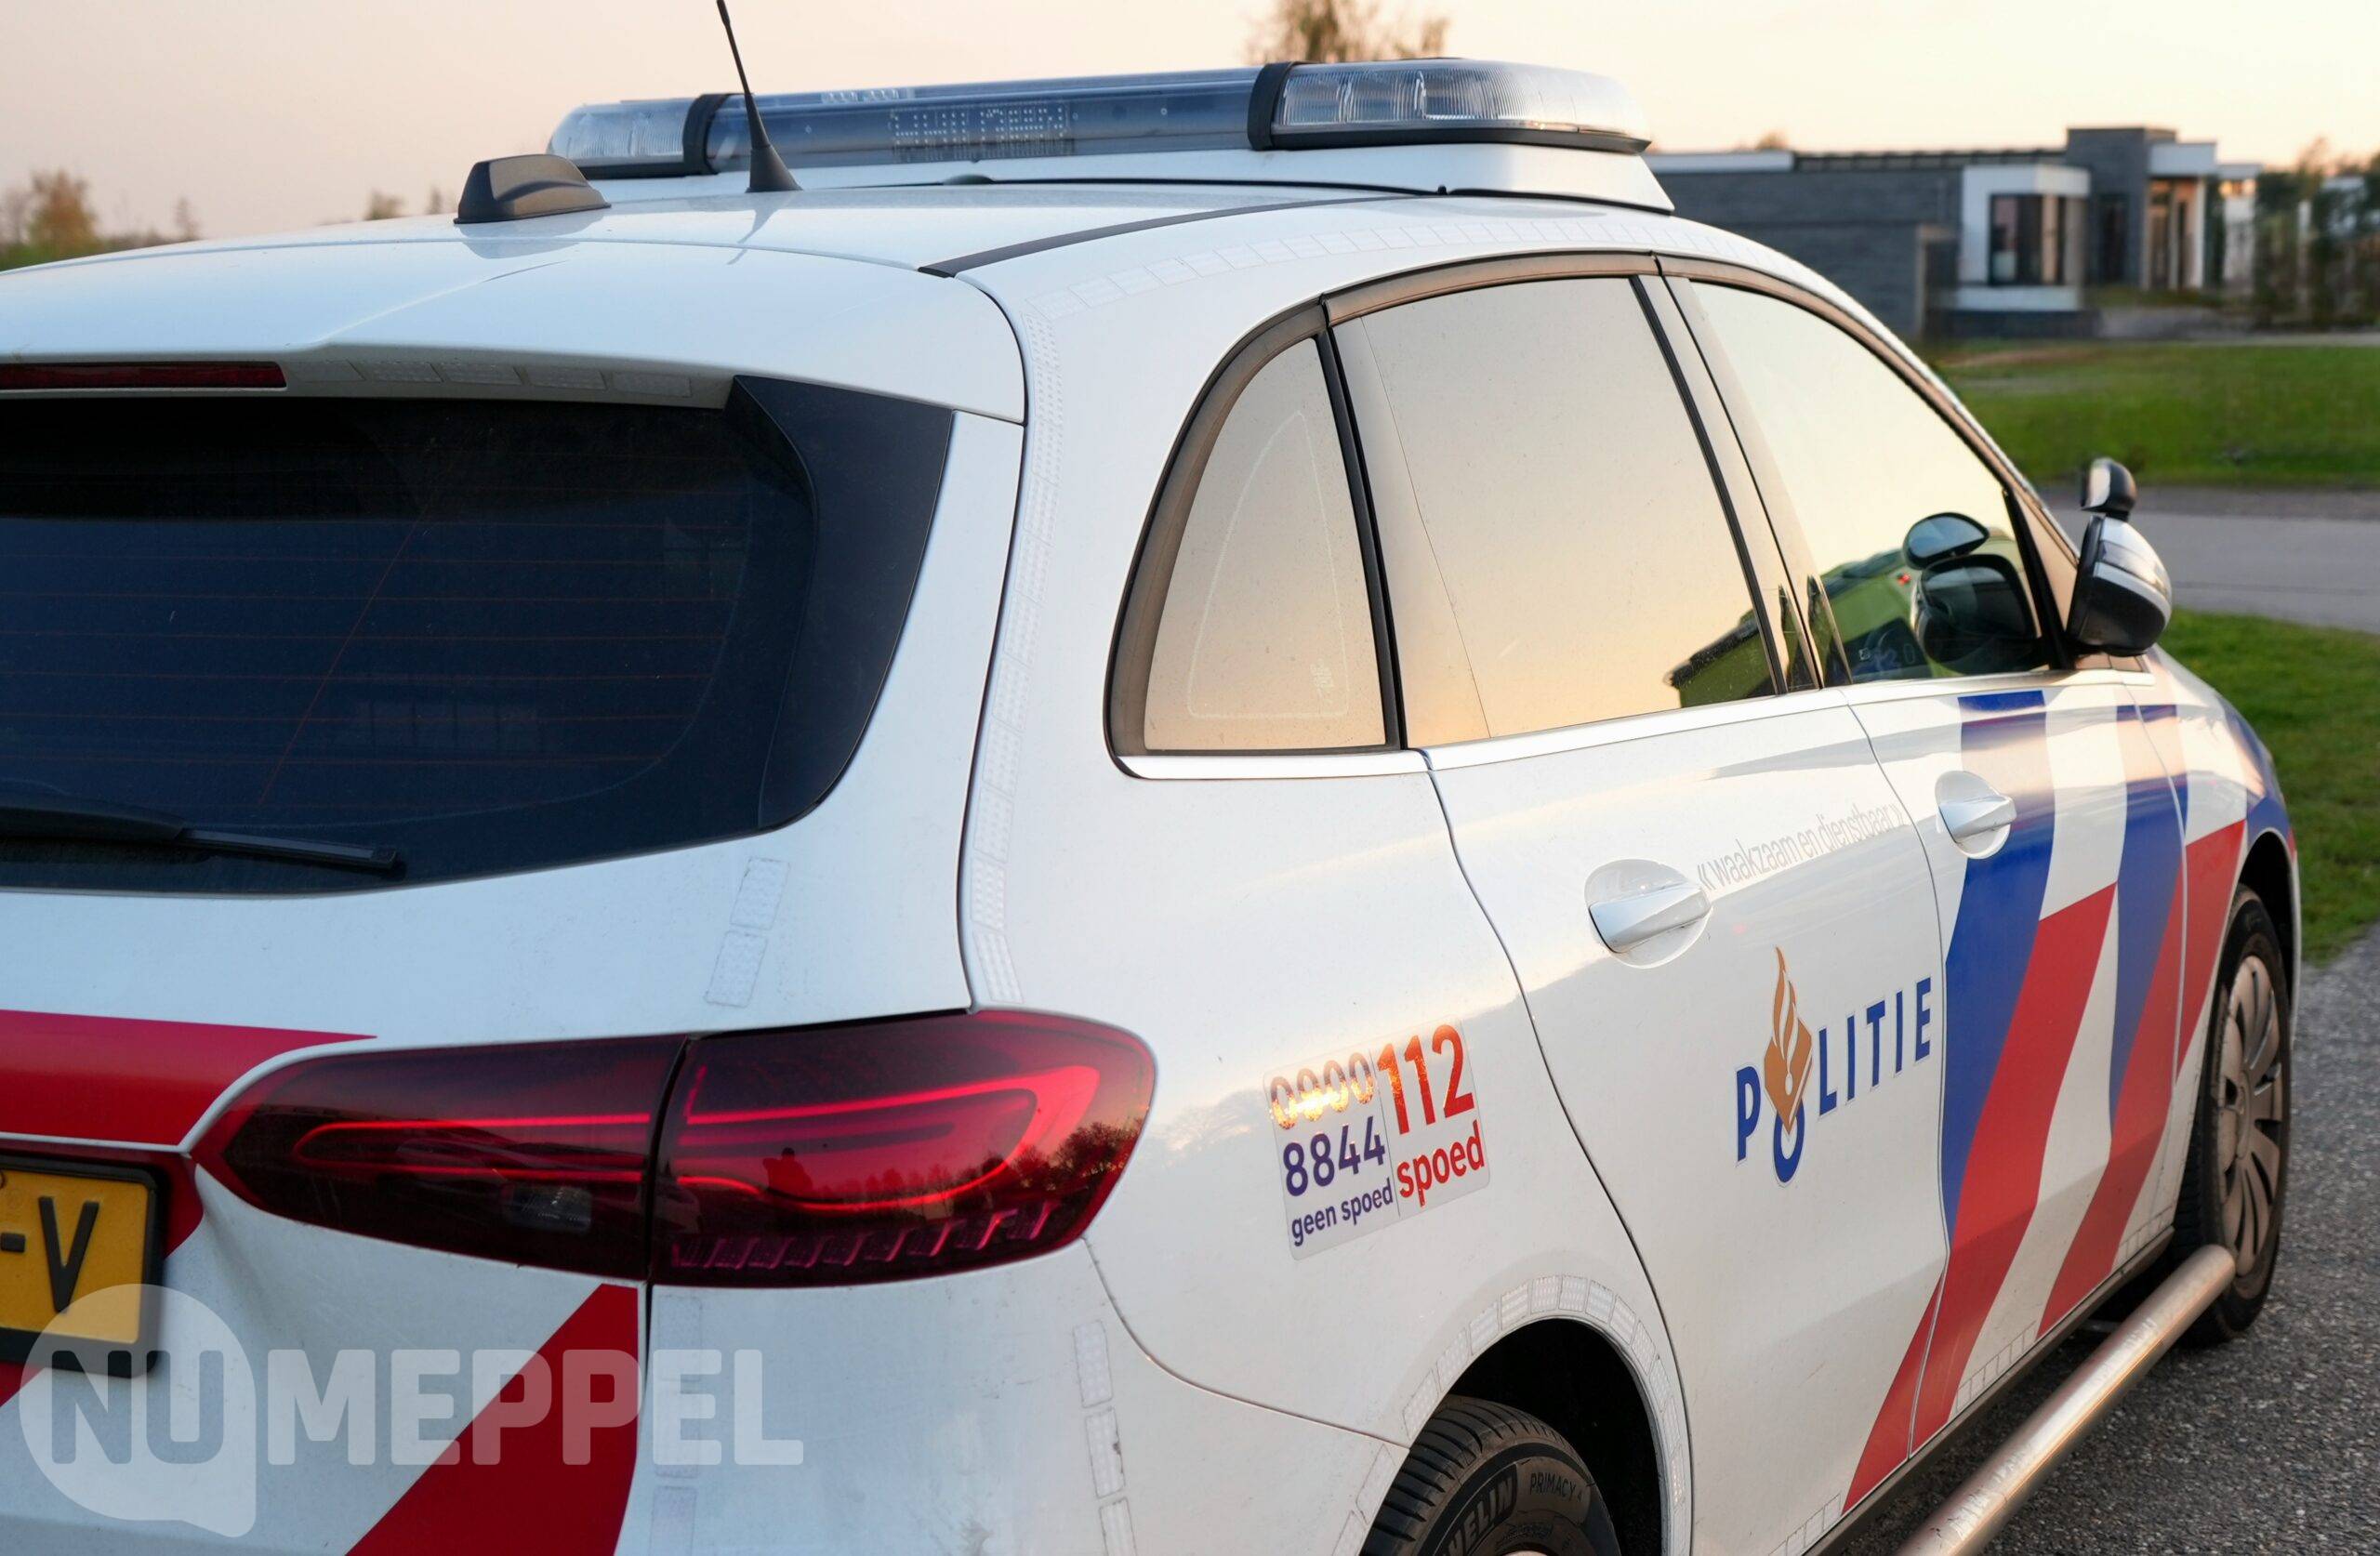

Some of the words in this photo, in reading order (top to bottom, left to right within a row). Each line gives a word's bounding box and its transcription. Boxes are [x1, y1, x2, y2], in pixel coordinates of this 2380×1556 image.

[1709, 837, 1800, 887] waakzaam
[1798, 827, 1823, 860] en
[1816, 802, 1892, 854] dienstbaar
[1376, 1023, 1475, 1136] 112
[1735, 976, 1932, 1183] POLITIE
[1283, 1115, 1386, 1197] 8844
[1396, 1119, 1486, 1208] spoed
[1291, 1205, 1338, 1247] geen
[1341, 1176, 1395, 1226] spoed
[1528, 1471, 1578, 1502] PRIMACY
